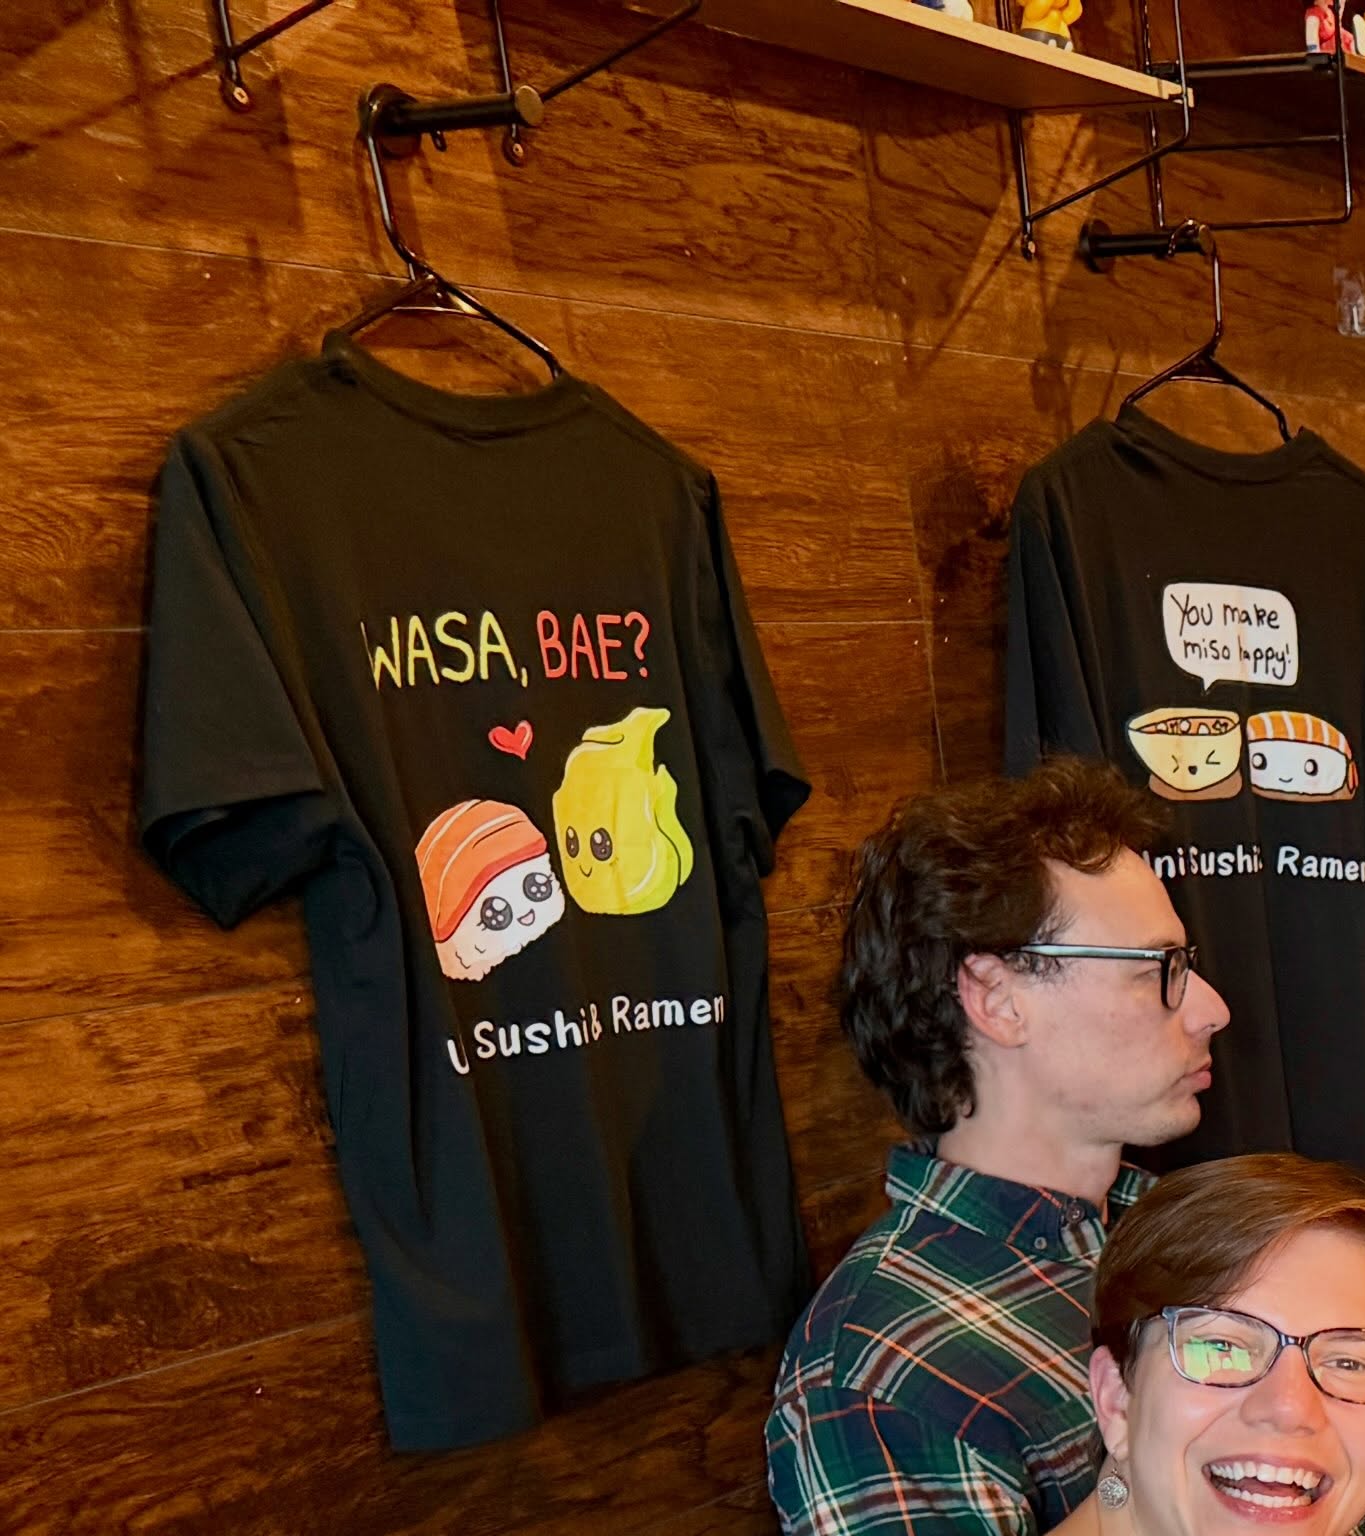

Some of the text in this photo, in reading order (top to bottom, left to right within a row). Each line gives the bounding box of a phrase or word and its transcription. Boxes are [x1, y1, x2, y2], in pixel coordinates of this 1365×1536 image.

[1169, 592, 1281, 637] You make
[360, 609, 651, 692] WASA, BAE?
[1182, 637, 1232, 661] miso
[473, 1006, 591, 1060] Sushi
[610, 994, 725, 1034] Ramen
